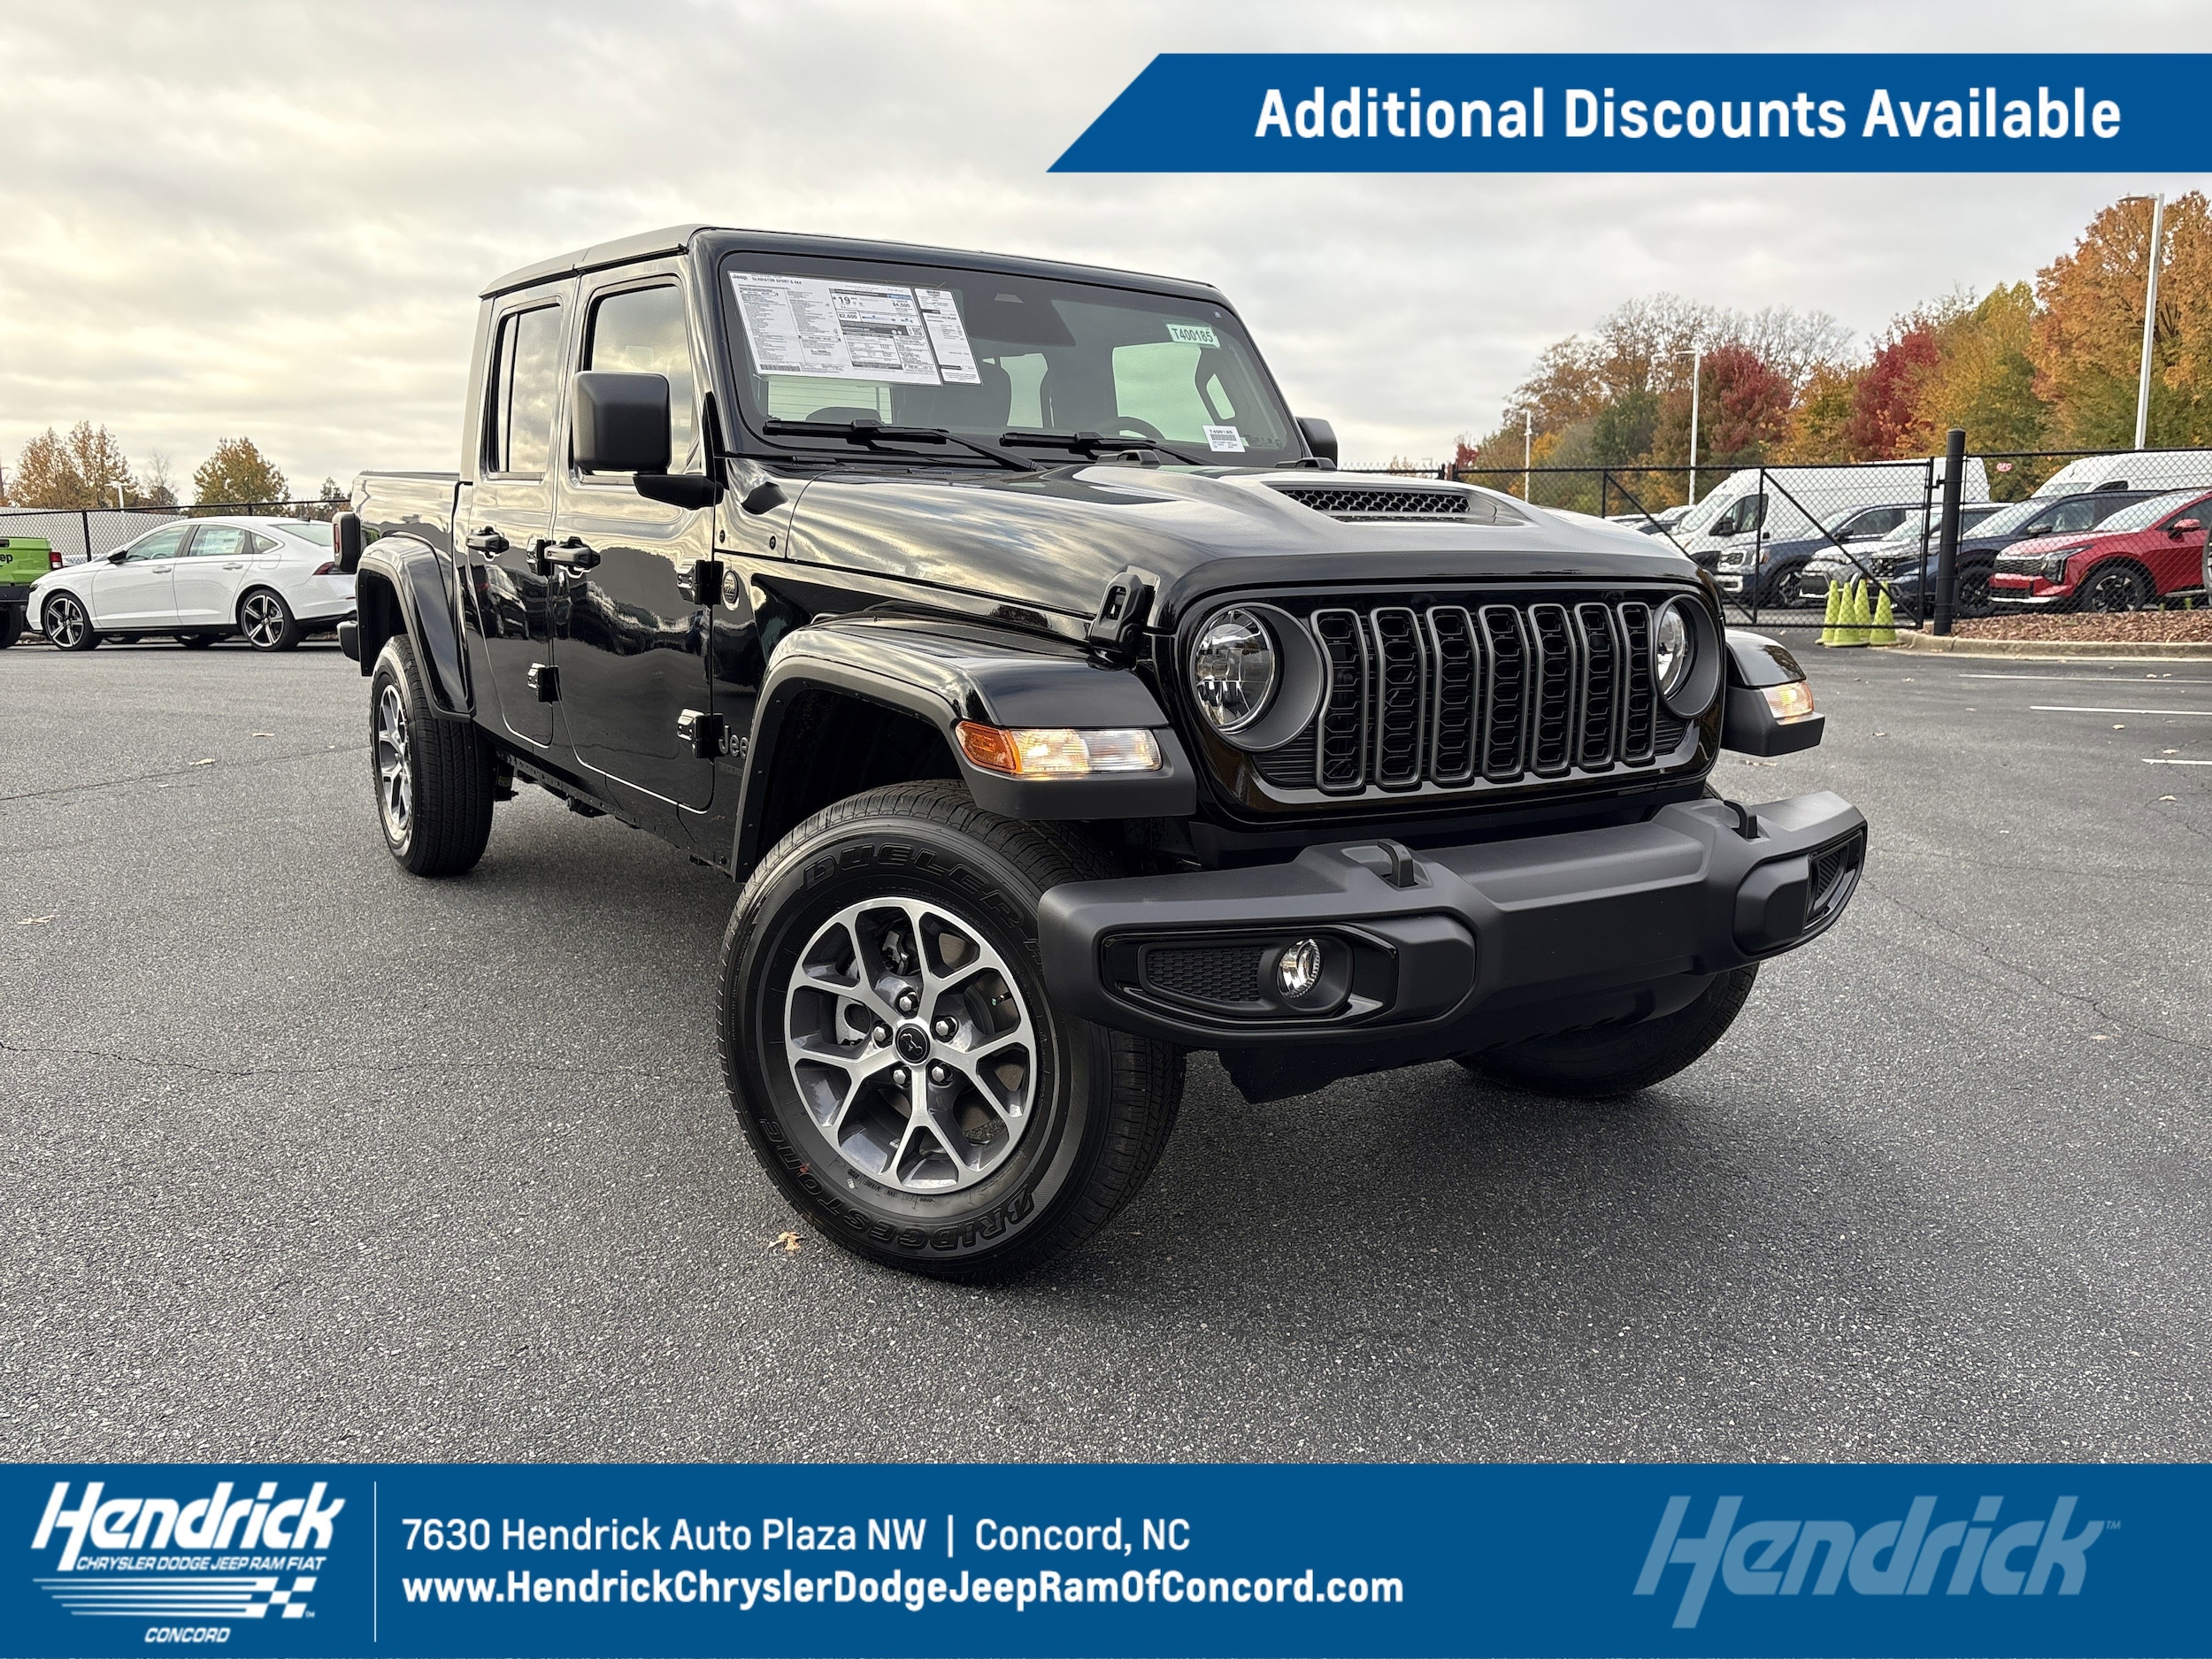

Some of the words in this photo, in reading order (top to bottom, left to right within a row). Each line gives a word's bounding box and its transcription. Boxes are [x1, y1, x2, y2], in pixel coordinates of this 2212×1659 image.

[1171, 327, 1213, 342] T400185
[804, 842, 1025, 928] DUELER
[759, 1118, 1034, 1251] BRIDGESTONE
